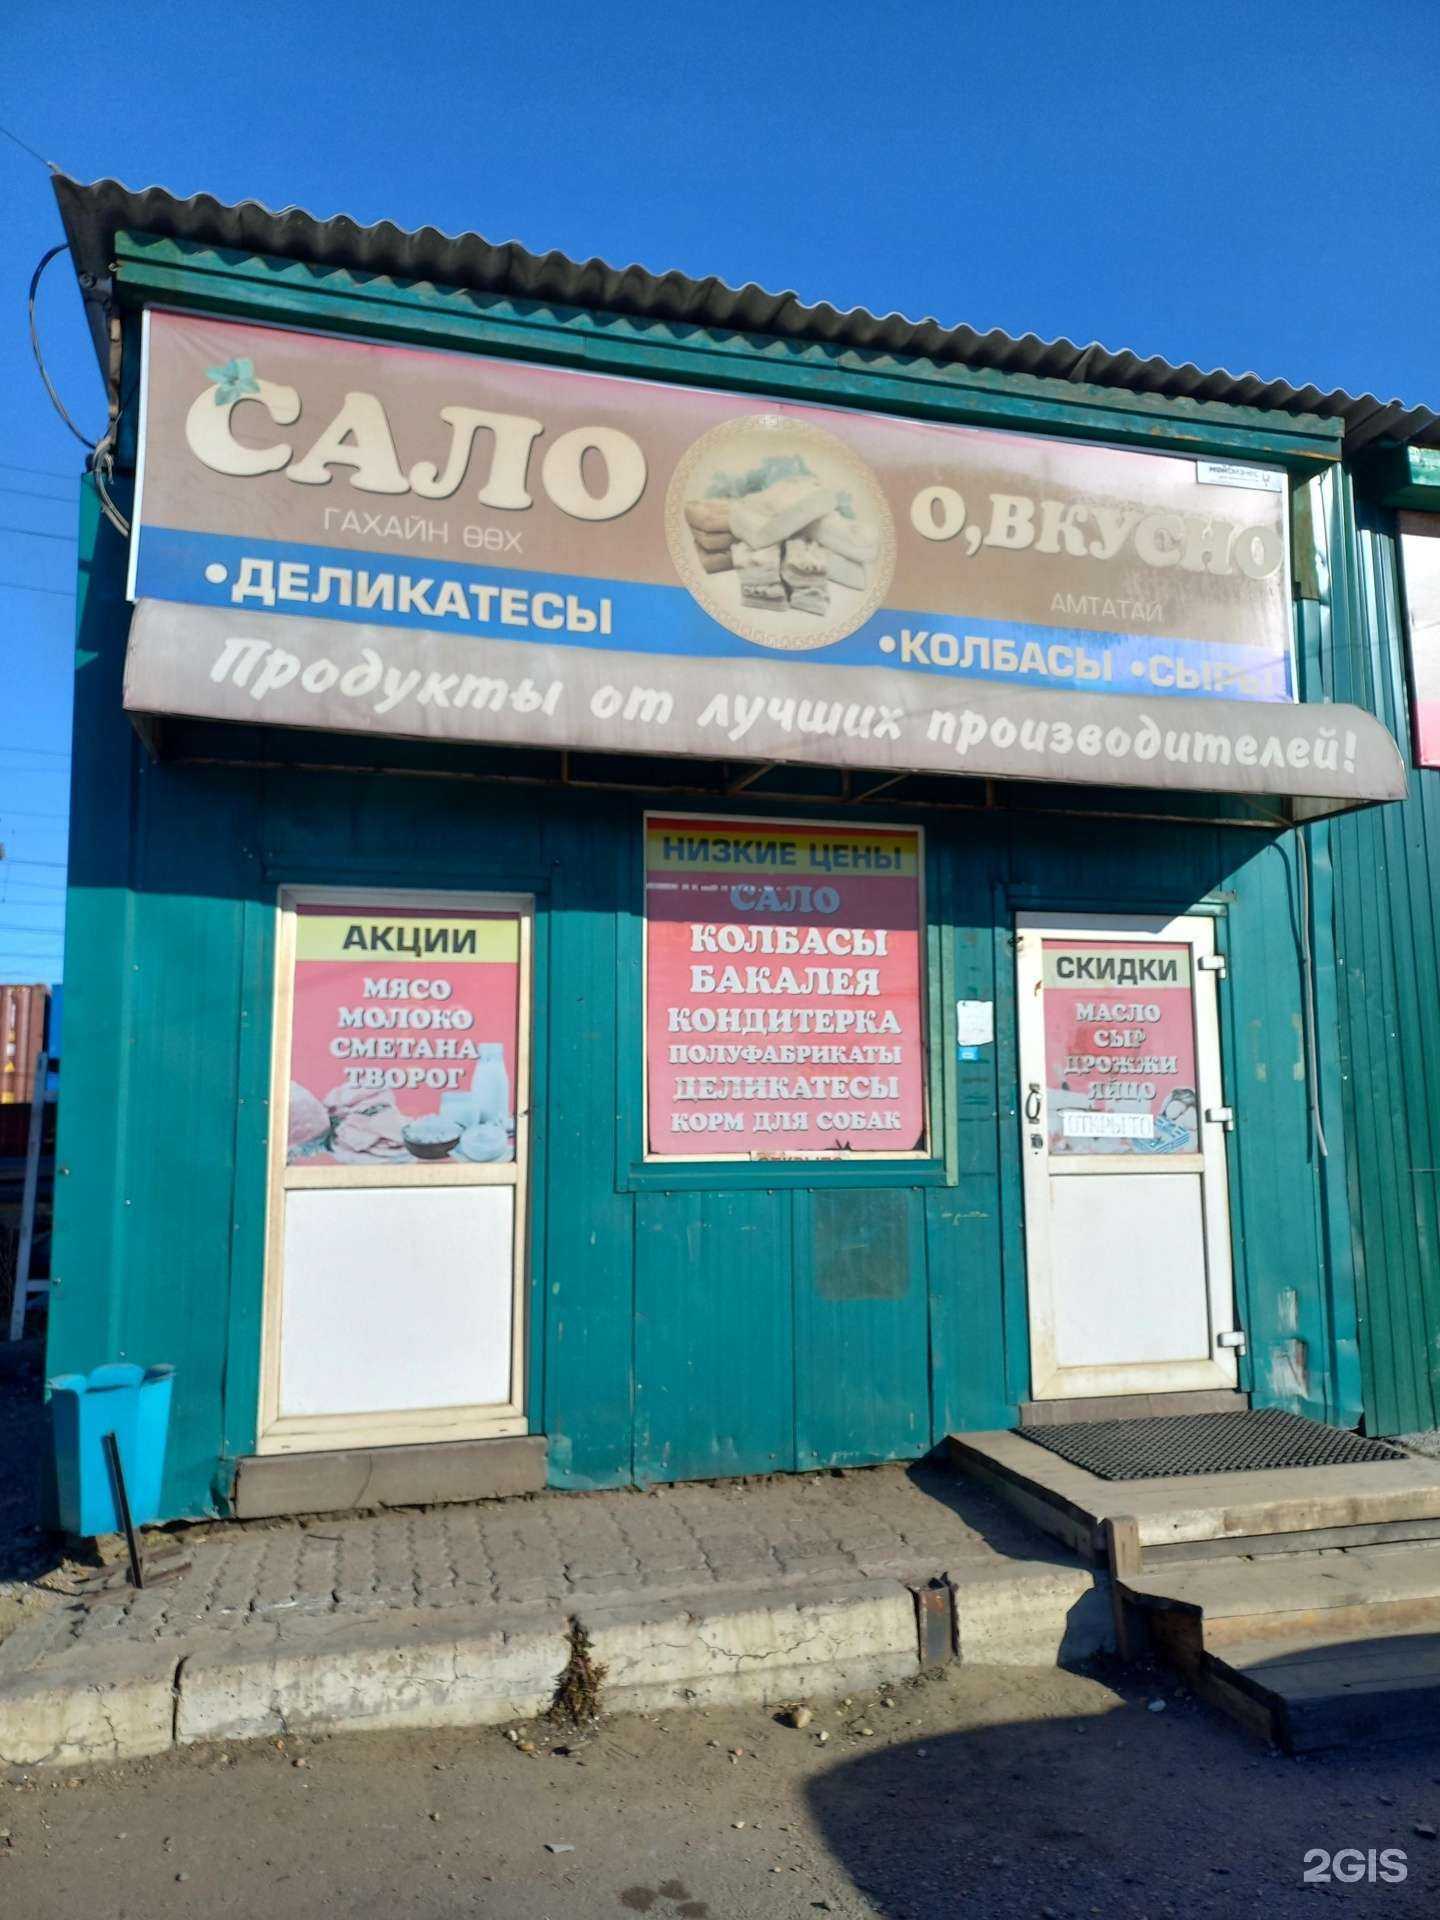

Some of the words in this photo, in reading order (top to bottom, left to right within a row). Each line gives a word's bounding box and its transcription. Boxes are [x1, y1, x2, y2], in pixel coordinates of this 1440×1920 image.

[185, 377, 647, 521] САЛО
[322, 507, 449, 545] ГАХАЙН
[463, 526, 524, 554] ӨӨХ
[231, 556, 613, 635] ДЕЛИКАТЕСЫ
[900, 629, 1113, 683] КОЛБАСЫ
[208, 637, 564, 716] Продукты
[589, 684, 675, 724] от
[696, 692, 905, 742] лучших
[926, 707, 1358, 775] производителей!
[662, 836, 798, 866] НИЗКИЕ
[808, 841, 904, 872] ЦЕНЫ
[729, 885, 842, 915] САЛО
[342, 925, 477, 958] АКЦИИ
[690, 923, 889, 957] КОЛБАСЫ
[689, 964, 881, 997] БАКАЛЕЯ
[1056, 956, 1177, 986] СКИДКИ
[362, 976, 453, 1001] МЯСО
[337, 1007, 475, 1031] МОЛОКО
[667, 1007, 903, 1036] КОНДИТЕРКА
[1075, 1002, 1161, 1023] МАСЛО
[329, 1037, 480, 1060] СМЕТАНА
[1093, 1029, 1146, 1048] СЫР
[668, 1044, 903, 1065] ПОЛУФАБРИКАТЫ
[1063, 1055, 1177, 1076] ДРОЖЖИ
[343, 1067, 465, 1090] ТВОРОГ
[672, 1076, 900, 1102] ДЕЛИКАТЕСЫ
[670, 1111, 745, 1133] КОРМ
[752, 1111, 809, 1133] ДЛЯ
[815, 1111, 903, 1131] СОБАК
